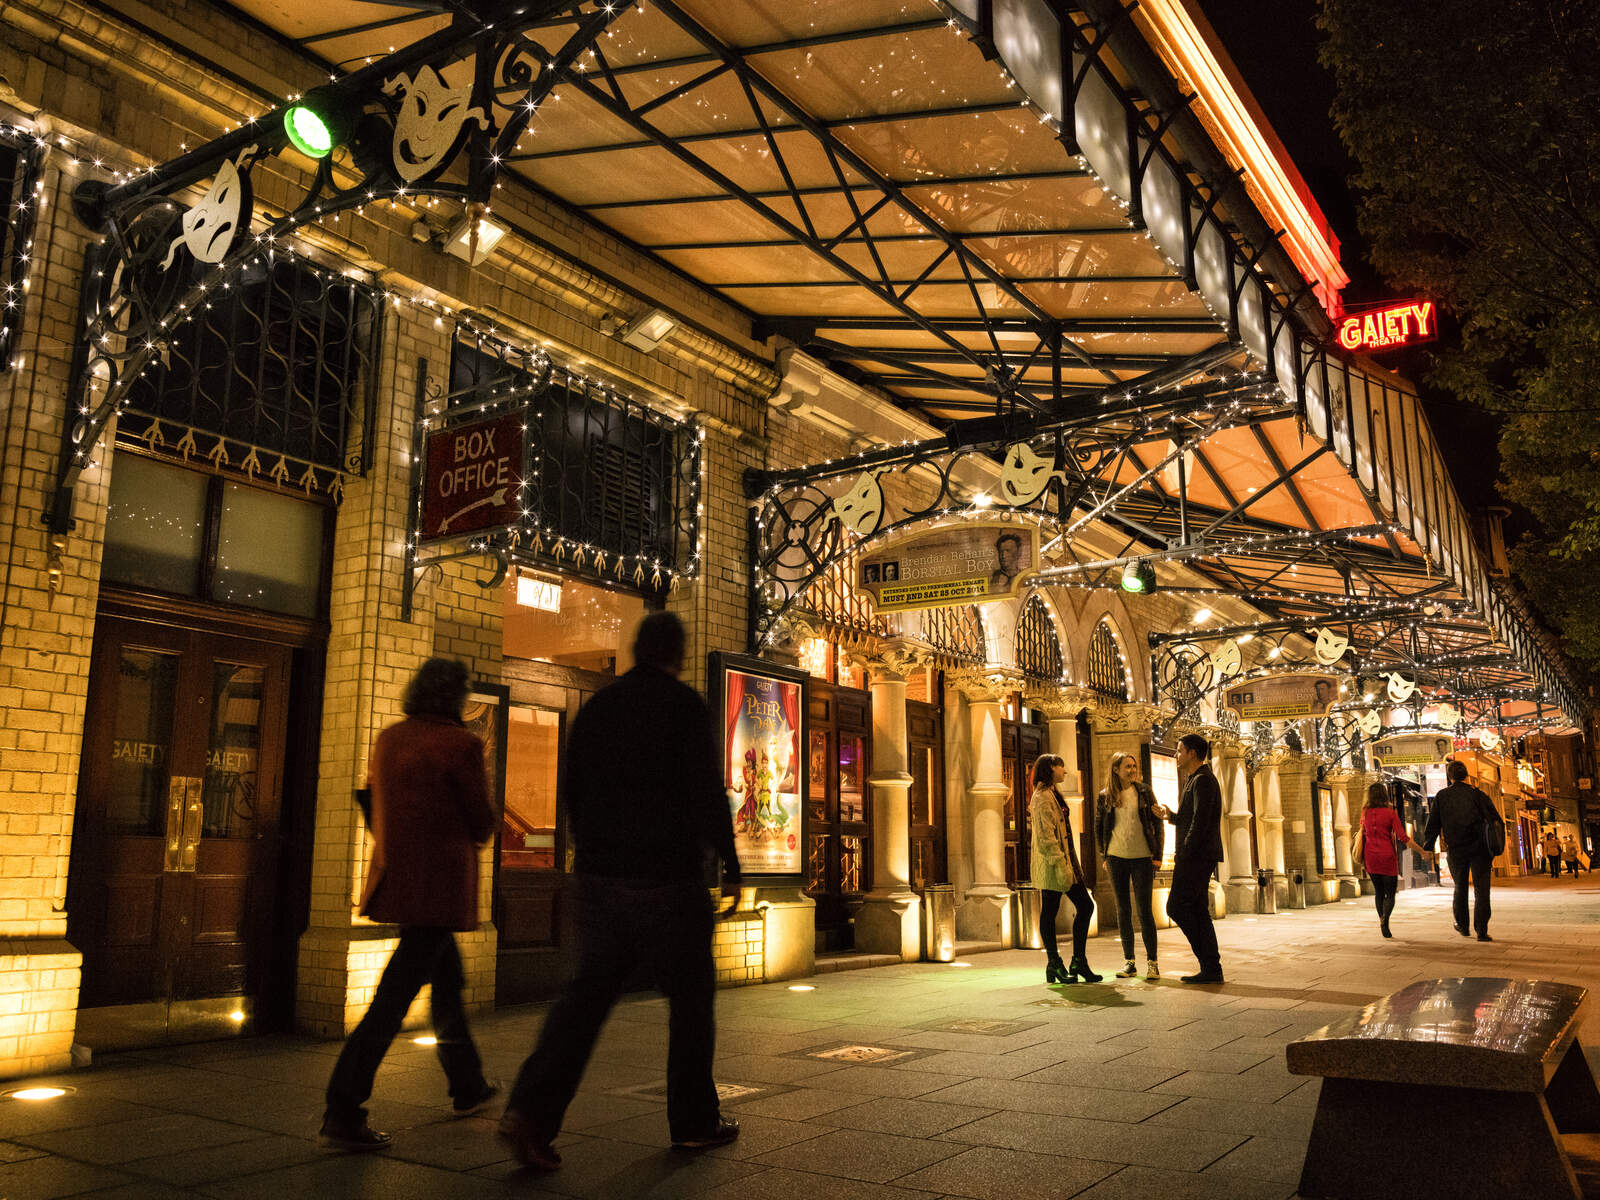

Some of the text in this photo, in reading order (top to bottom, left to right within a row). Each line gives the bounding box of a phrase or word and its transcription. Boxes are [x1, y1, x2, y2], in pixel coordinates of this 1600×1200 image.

[1341, 302, 1431, 349] GAIETY
[1369, 335, 1405, 348] THEATRE
[454, 427, 496, 462] BOX
[440, 457, 510, 497] OFFICE
[901, 552, 947, 568] Brendan
[962, 579, 985, 587] DEMAND
[883, 595, 905, 603] MUST
[906, 593, 922, 601] END
[923, 591, 939, 599] SAT
[950, 588, 966, 596] OCT
[744, 693, 783, 721] PETER
